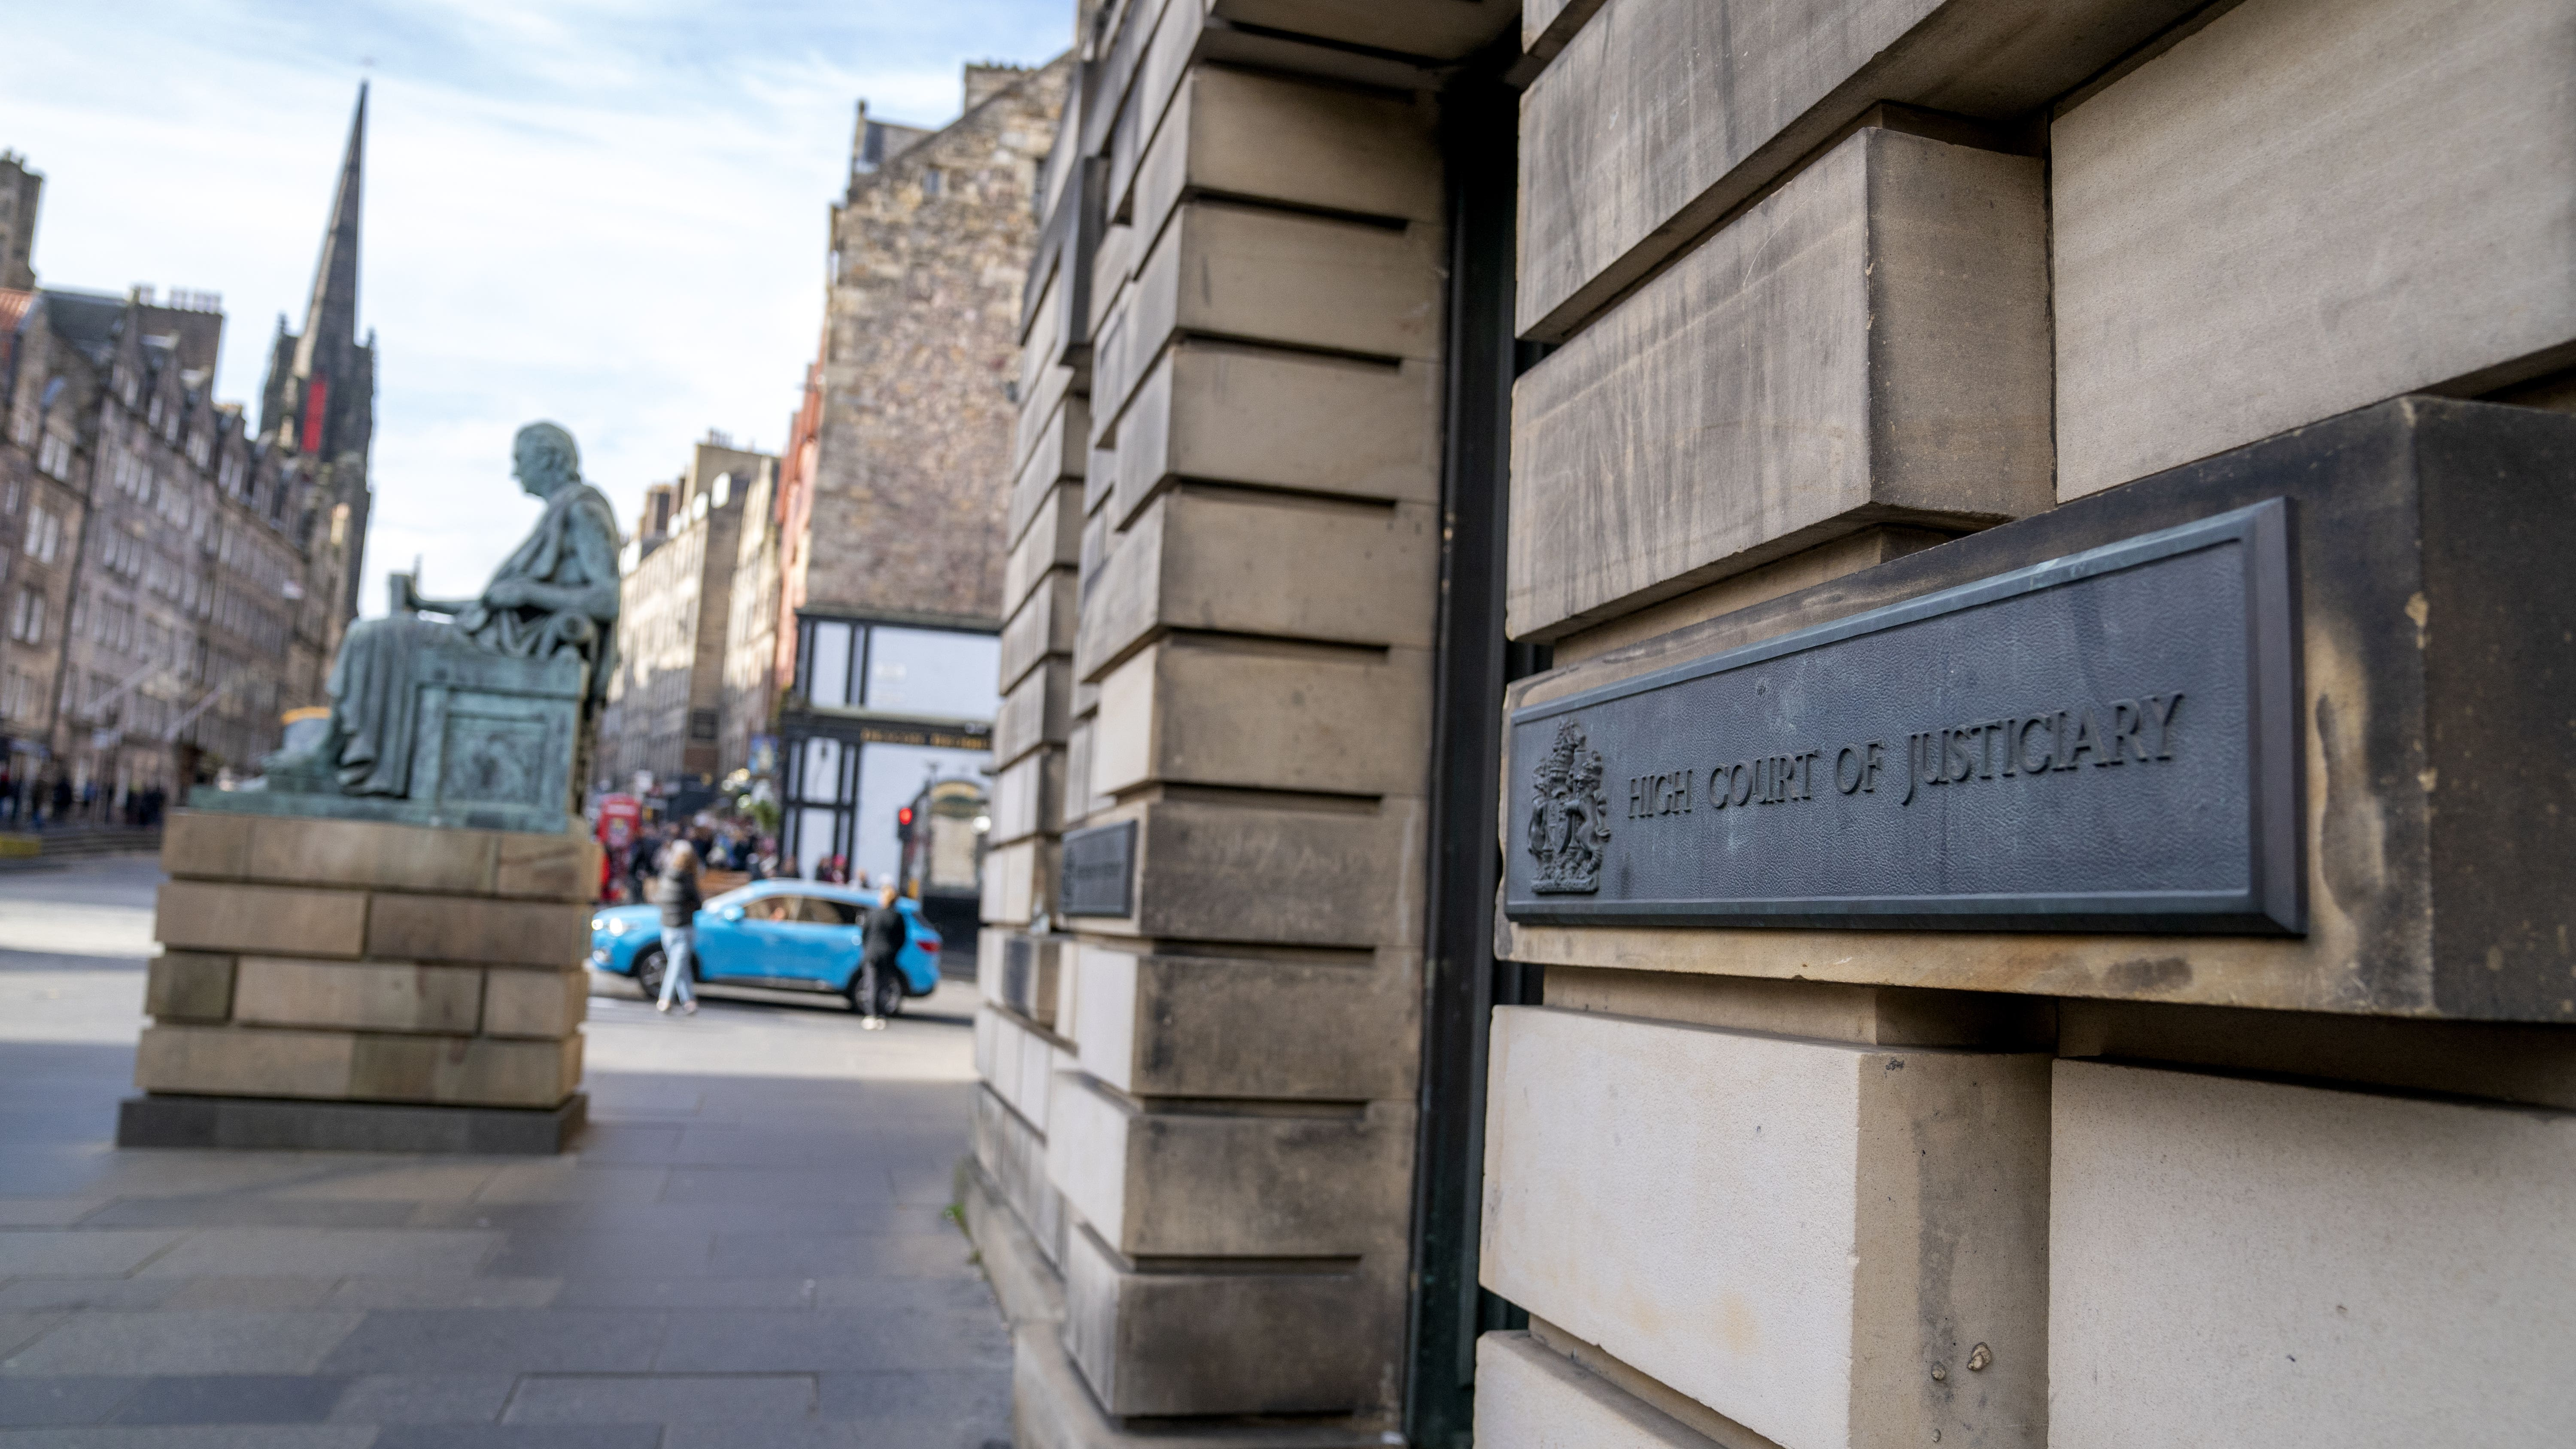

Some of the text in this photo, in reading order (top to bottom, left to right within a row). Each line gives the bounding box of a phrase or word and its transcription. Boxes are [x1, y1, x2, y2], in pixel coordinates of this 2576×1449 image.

[1628, 693, 2184, 818] HIGH COURT OF JUSTICIARY
